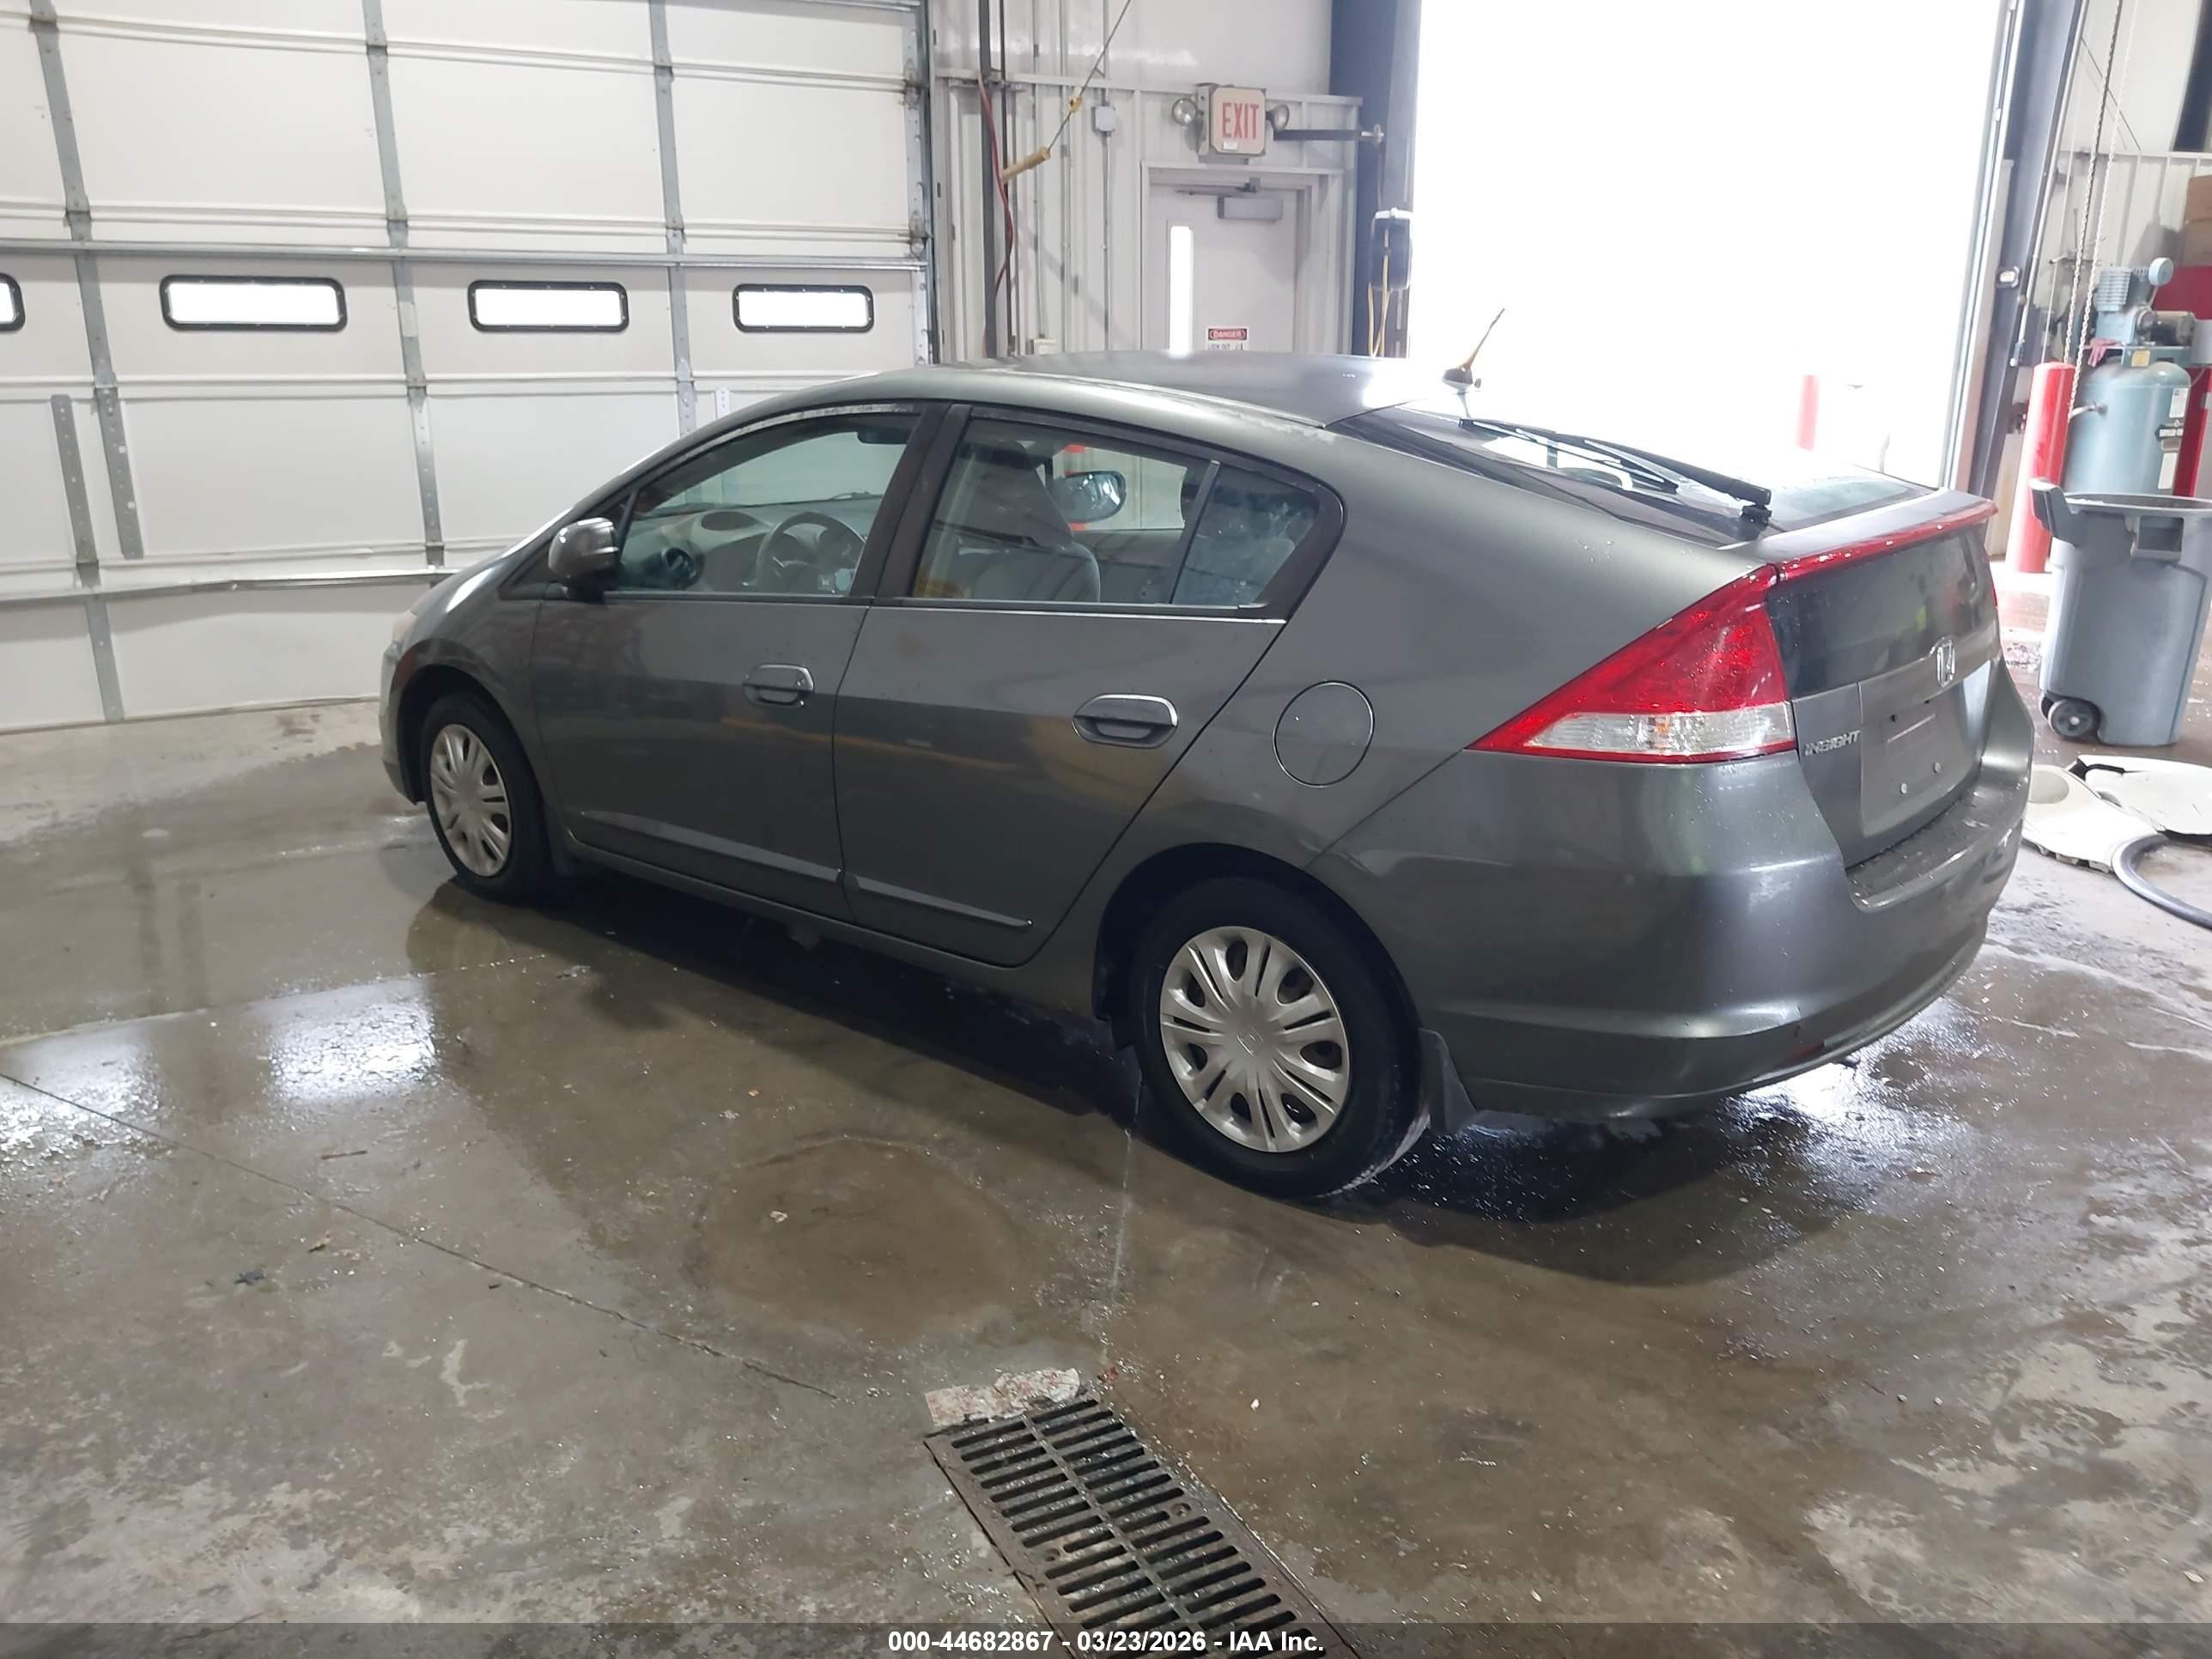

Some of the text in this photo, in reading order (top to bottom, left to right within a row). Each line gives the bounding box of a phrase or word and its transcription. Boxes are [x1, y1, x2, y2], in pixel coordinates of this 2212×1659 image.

[1222, 102, 1259, 139] EXIT
[1212, 330, 1242, 338] DANGER
[1804, 729, 1861, 757] INSIGHT
